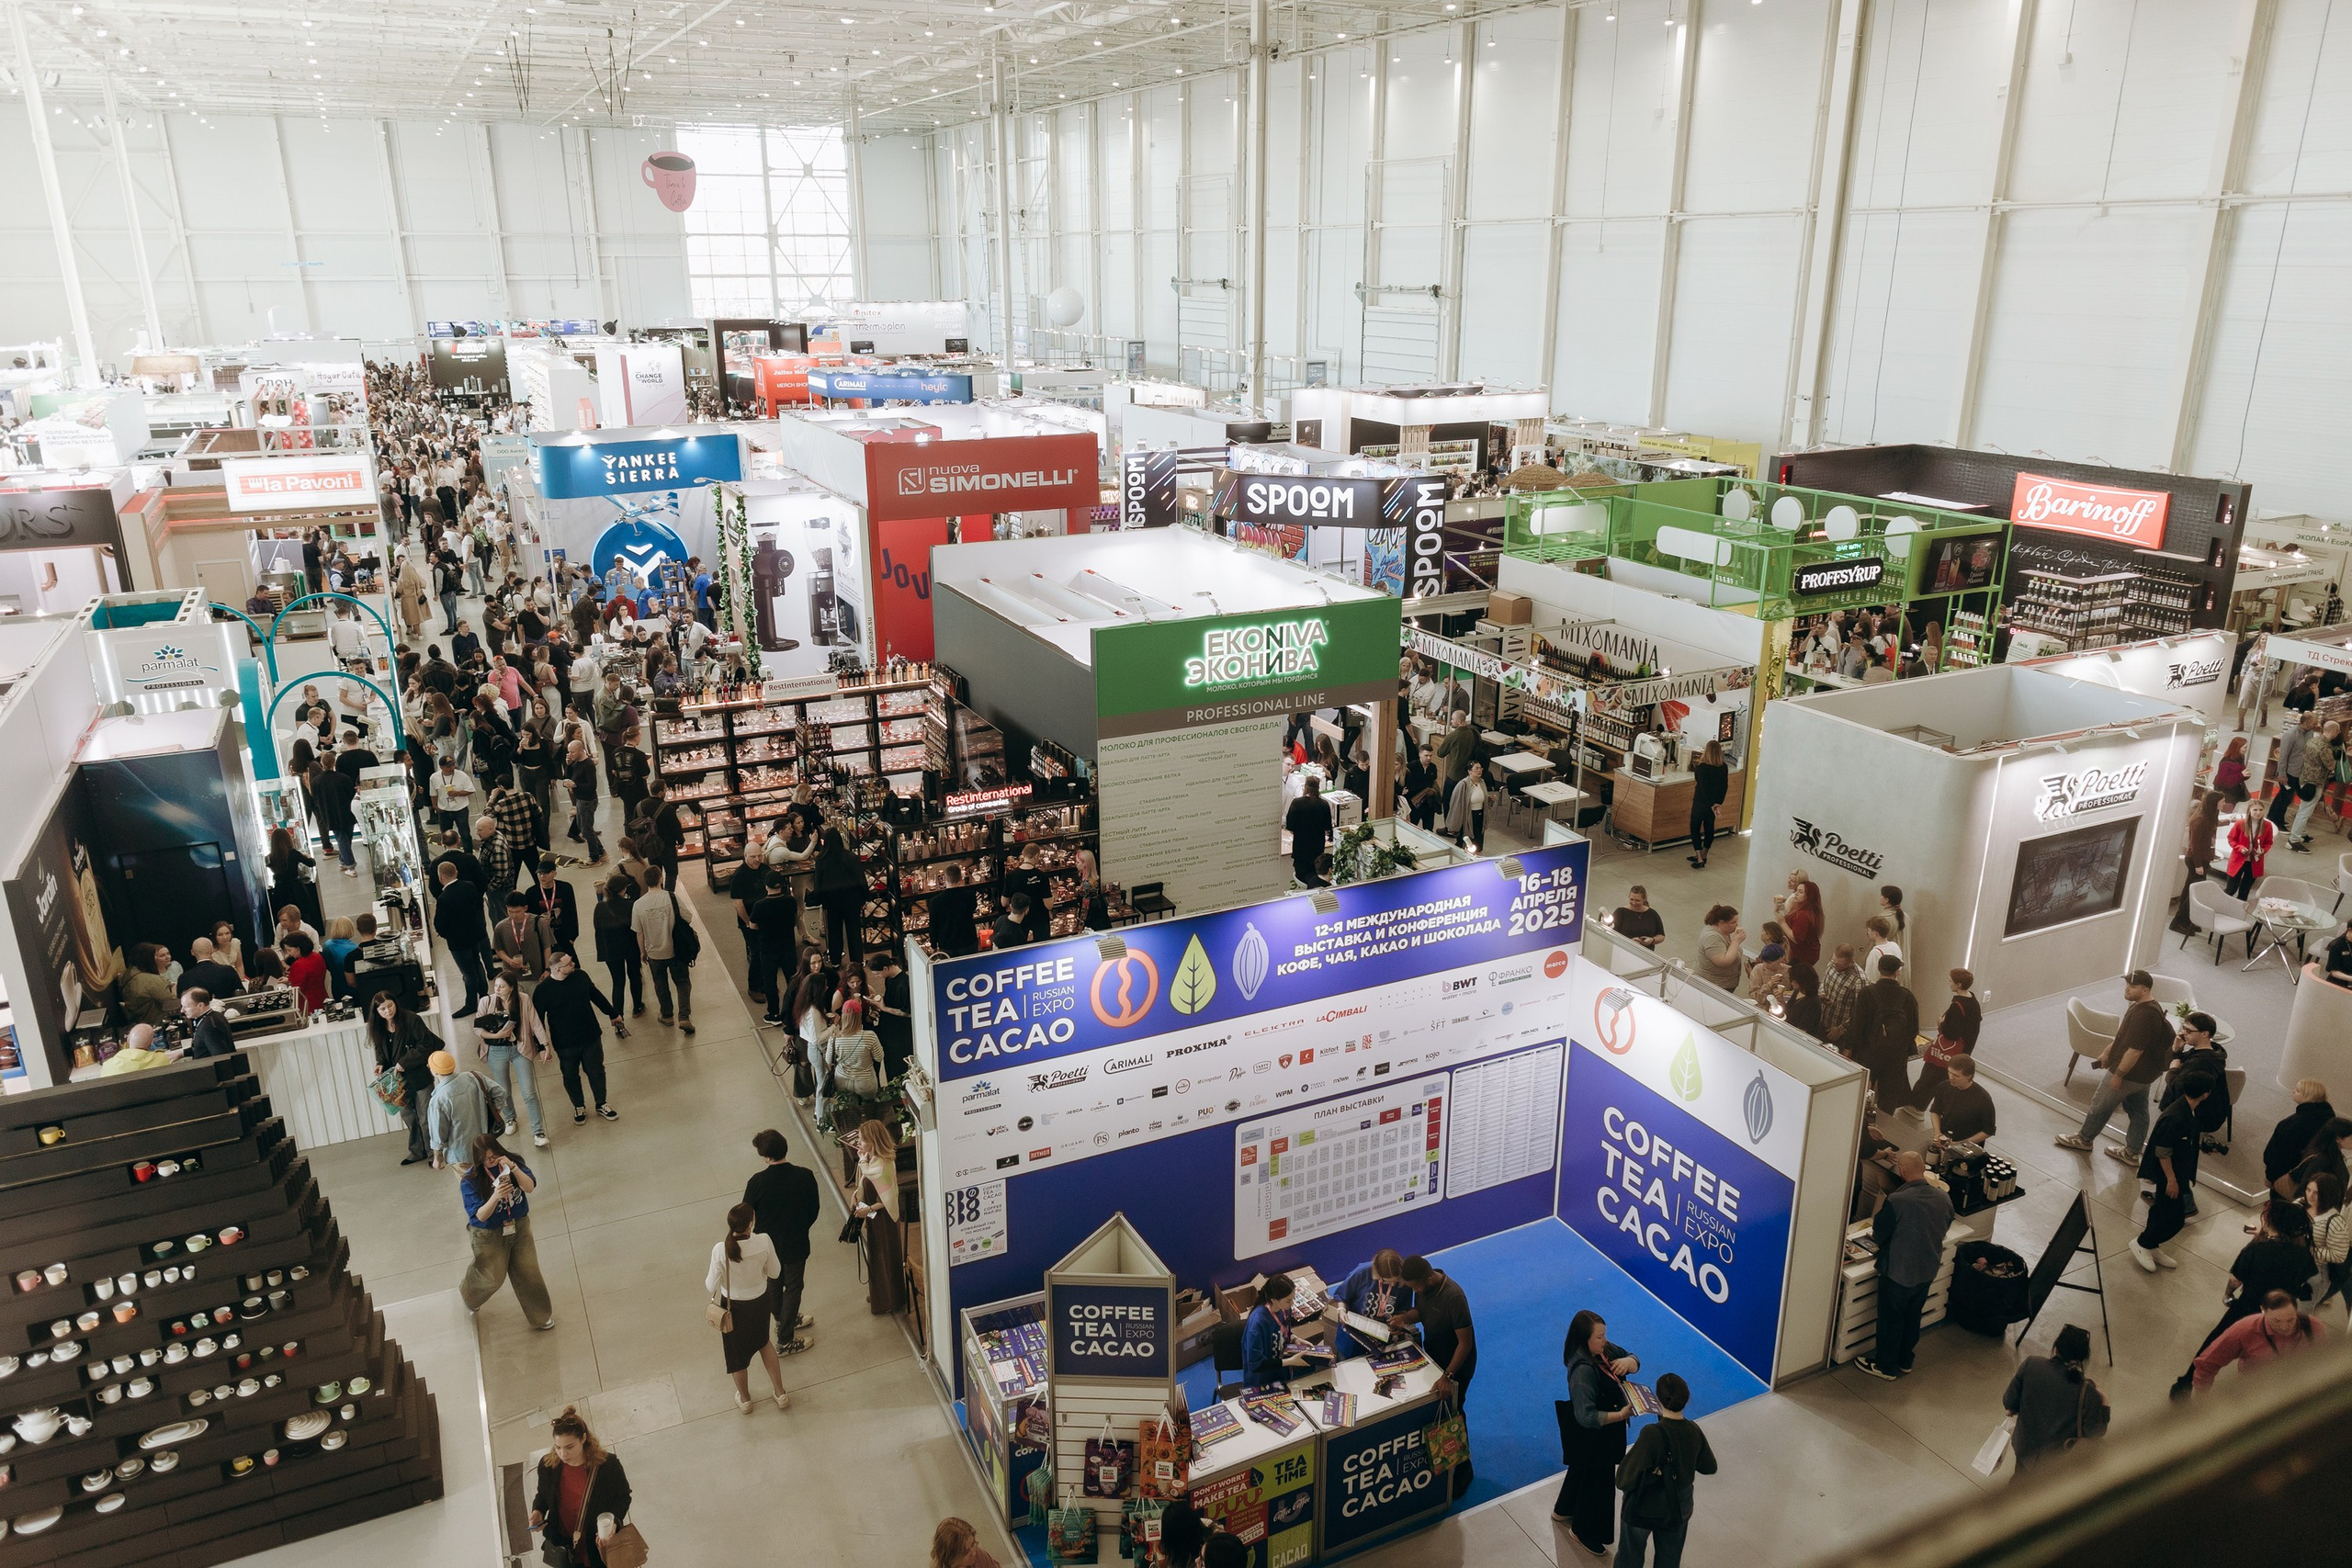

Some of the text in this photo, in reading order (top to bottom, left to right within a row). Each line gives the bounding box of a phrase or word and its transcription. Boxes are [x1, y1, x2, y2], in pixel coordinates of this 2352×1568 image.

[317, 371, 340, 383] Hogar
[833, 378, 866, 390] CARIMALI
[601, 451, 677, 469] YANKEE
[928, 464, 980, 475] nuova
[285, 473, 355, 490] Pavoni
[605, 467, 680, 485] SIERRA
[929, 468, 1073, 493] SIMONELLI
[1127, 457, 1146, 527] SPOOM
[1247, 483, 1354, 520] SPOOM
[2018, 482, 2156, 536] Barinoff
[1415, 482, 1445, 597] SPOOM
[2296, 534, 2324, 543] ЭКОПАК
[1801, 565, 1881, 589] PROFFSYRUP
[1207, 621, 1328, 657] EKONIVA
[2307, 650, 2320, 660] ТД
[141, 657, 199, 673] parmalat
[1186, 649, 1318, 684] ЭКОНИВА
[2186, 657, 2225, 676] Poetti
[146, 681, 203, 689] PROFESSIONAL
[768, 677, 832, 691] RestInternational
[1207, 683, 1237, 693] МОЛОКО,
[1238, 680, 1271, 689] КОТОРЫМ
[1284, 674, 1318, 683] ГОРДИМСЯ
[1187, 693, 1325, 722] PROFESSIONAL LINE
[1101, 741, 1136, 751] МОЛОКО
[1156, 728, 1228, 744] ПРОФЕССИОНАЛОВ
[1230, 725, 1258, 734] СВОЕГО
[1260, 721, 1281, 730] ДЕЛА!
[1126, 776, 1160, 784] СОДЕРЖАНИЕ
[2079, 761, 2149, 797] Poetti
[946, 784, 1032, 807] RestInternational
[1139, 796, 1170, 805] СТАБИЛЬНАЯ
[2077, 792, 2133, 810] PROFESSIONAL
[947, 805, 967, 813] Group
[975, 799, 1010, 809] companies
[1102, 829, 1129, 838] ЧЕСТНЫЙ
[1139, 839, 1170, 848] СТАБИЛЬНАЯ
[1825, 831, 1885, 871] Poetti
[1102, 857, 1126, 865] ВЫСОКОЕ
[1127, 852, 1163, 862] СОДЕРЖАНИЕ
[1147, 859, 1181, 868] СТАБИЛЬНАЯ
[1822, 852, 1871, 879] PROFESSIONAL
[1140, 871, 1170, 880] СТАБИЛЬНАЯ
[1518, 867, 1573, 895] 16-18
[1198, 882, 1221, 890] ЧЕСТНЫЙ
[1233, 886, 1261, 894] СТАБИЛЬНАЯ
[1510, 885, 1577, 912] АПРЕЛЯ
[1314, 895, 1472, 938] 12-Я МЕЖДУНАРОДНАЯ
[1507, 902, 1576, 937] 2025
[1295, 906, 1488, 956] ВЫСТАВКА И КОНФЕРЕНЦИЯ
[1276, 919, 1501, 977] КОФЕ, ЧАЯ, КАКАО И ШОКОЛАДА
[1498, 965, 1532, 979] ФРАНКО
[1546, 961, 1566, 969] marco
[946, 956, 1075, 1001] COFFEE
[1453, 977, 1477, 990] BWT
[1033, 985, 1075, 1001] RUSSIAN
[947, 998, 1019, 1032] TEA
[1034, 997, 1074, 1017] EXPO
[949, 1017, 1075, 1064] CACAO
[1166, 1038, 1227, 1058] PROXIMA
[1320, 1045, 1339, 1055] Kitfort
[1050, 1066, 1090, 1082] Poetti
[1103, 1054, 1153, 1075] CARIMALI
[962, 1088, 1001, 1103] parmalat
[1275, 1089, 1293, 1098] WPM
[1314, 1095, 1385, 1120] ПЛАН ВЫСТАВКИ
[1118, 1127, 1140, 1138] planto
[1603, 1106, 1741, 1223] COFFEE
[1600, 1140, 1669, 1221] TEA
[961, 1223, 986, 1232] КОФЕЙНЫЙ
[1688, 1201, 1736, 1244] RUSSIAN
[1597, 1186, 1729, 1303] CACAO
[1685, 1216, 1734, 1264] EXPO
[1069, 1304, 1155, 1321] COFFEE
[1069, 1322, 1116, 1338] TEA
[1125, 1330, 1155, 1339] EXPO
[1069, 1339, 1155, 1358] CACAO
[1273, 1452, 1306, 1477] TEA
[1193, 1472, 1246, 1497] DON'T WORRY
[1275, 1466, 1306, 1485] TIME
[1343, 1463, 1393, 1495] TEA
[1194, 1483, 1247, 1508] MAKE TEA
[1342, 1470, 1432, 1517] CACAO
[1231, 1505, 1263, 1520] EVERYTHING
[1232, 1516, 1247, 1525] STOPS
[1231, 1517, 1261, 1531] CHOCOLATE
[1272, 1542, 1307, 1568] CACAO
